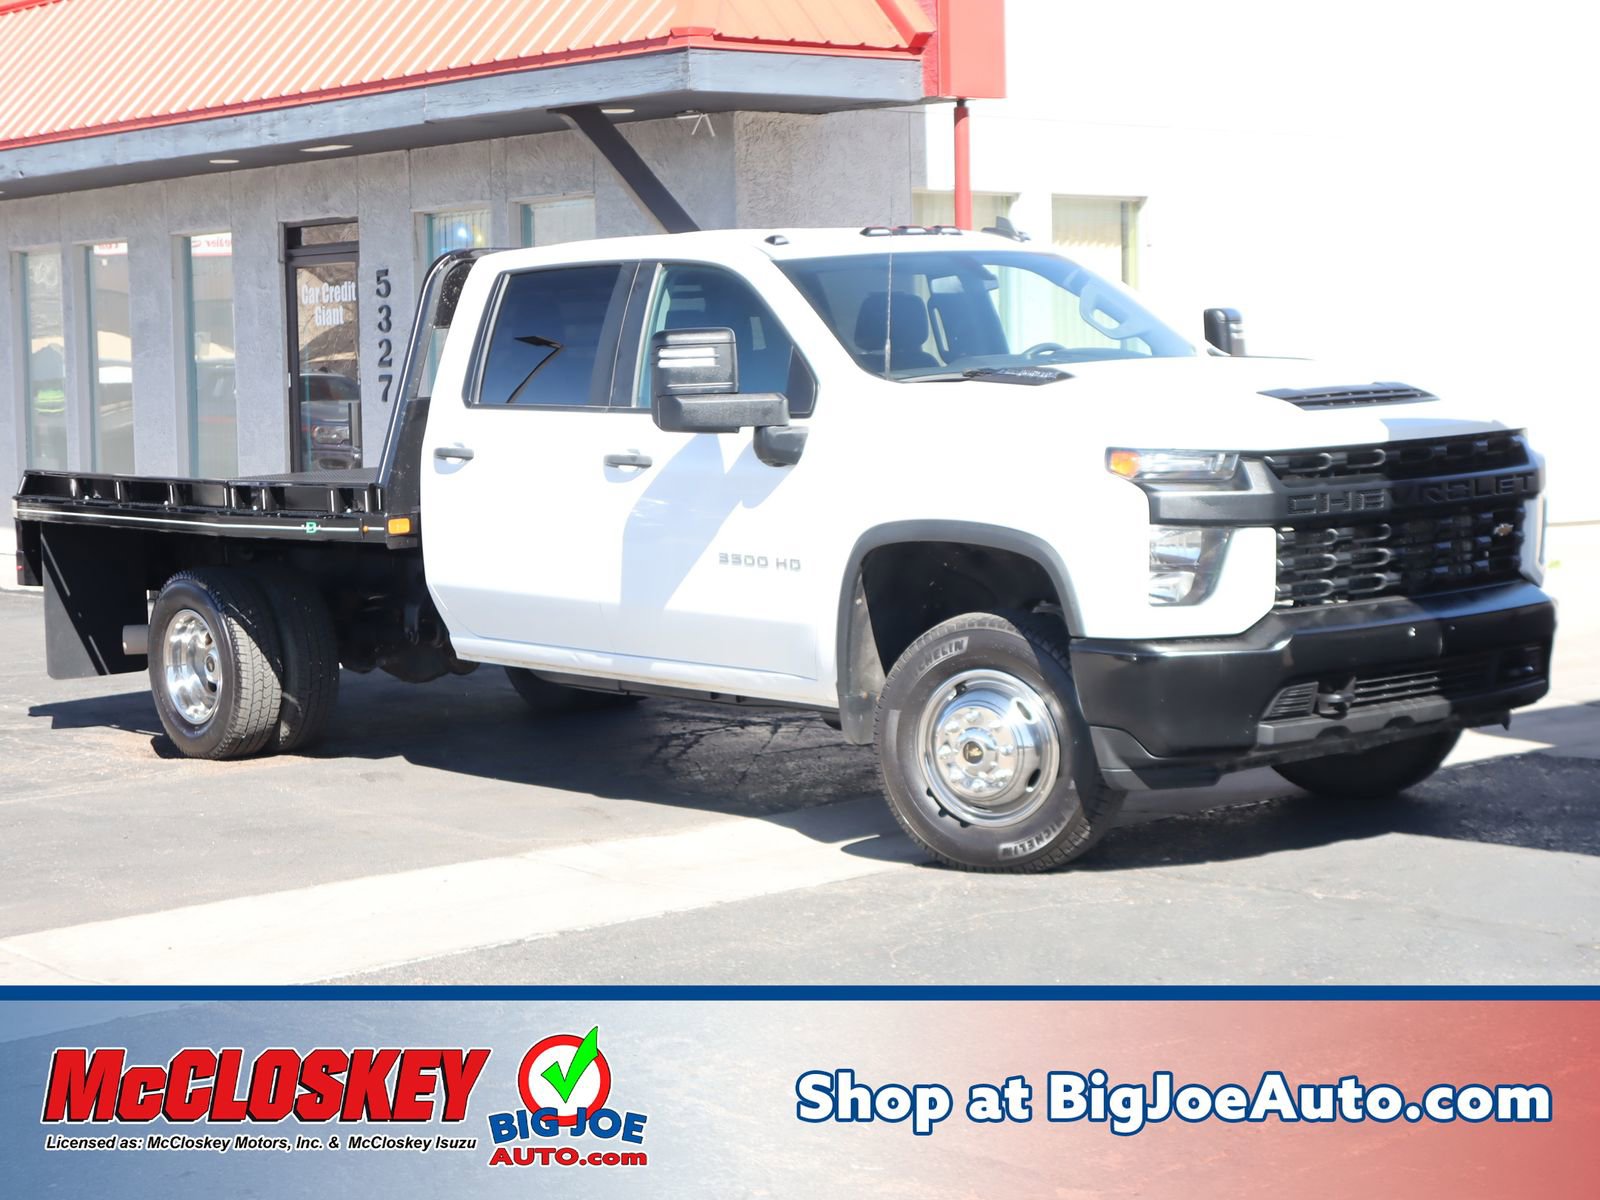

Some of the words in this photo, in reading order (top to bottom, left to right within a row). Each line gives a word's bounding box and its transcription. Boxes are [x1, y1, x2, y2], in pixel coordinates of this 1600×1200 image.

[301, 284, 321, 305] Car
[322, 281, 357, 303] Credit
[315, 305, 345, 327] Giant
[375, 268, 393, 402] 5327
[1287, 471, 1536, 515] CHEVROLET
[719, 552, 769, 568] 3500
[775, 557, 801, 572] HD
